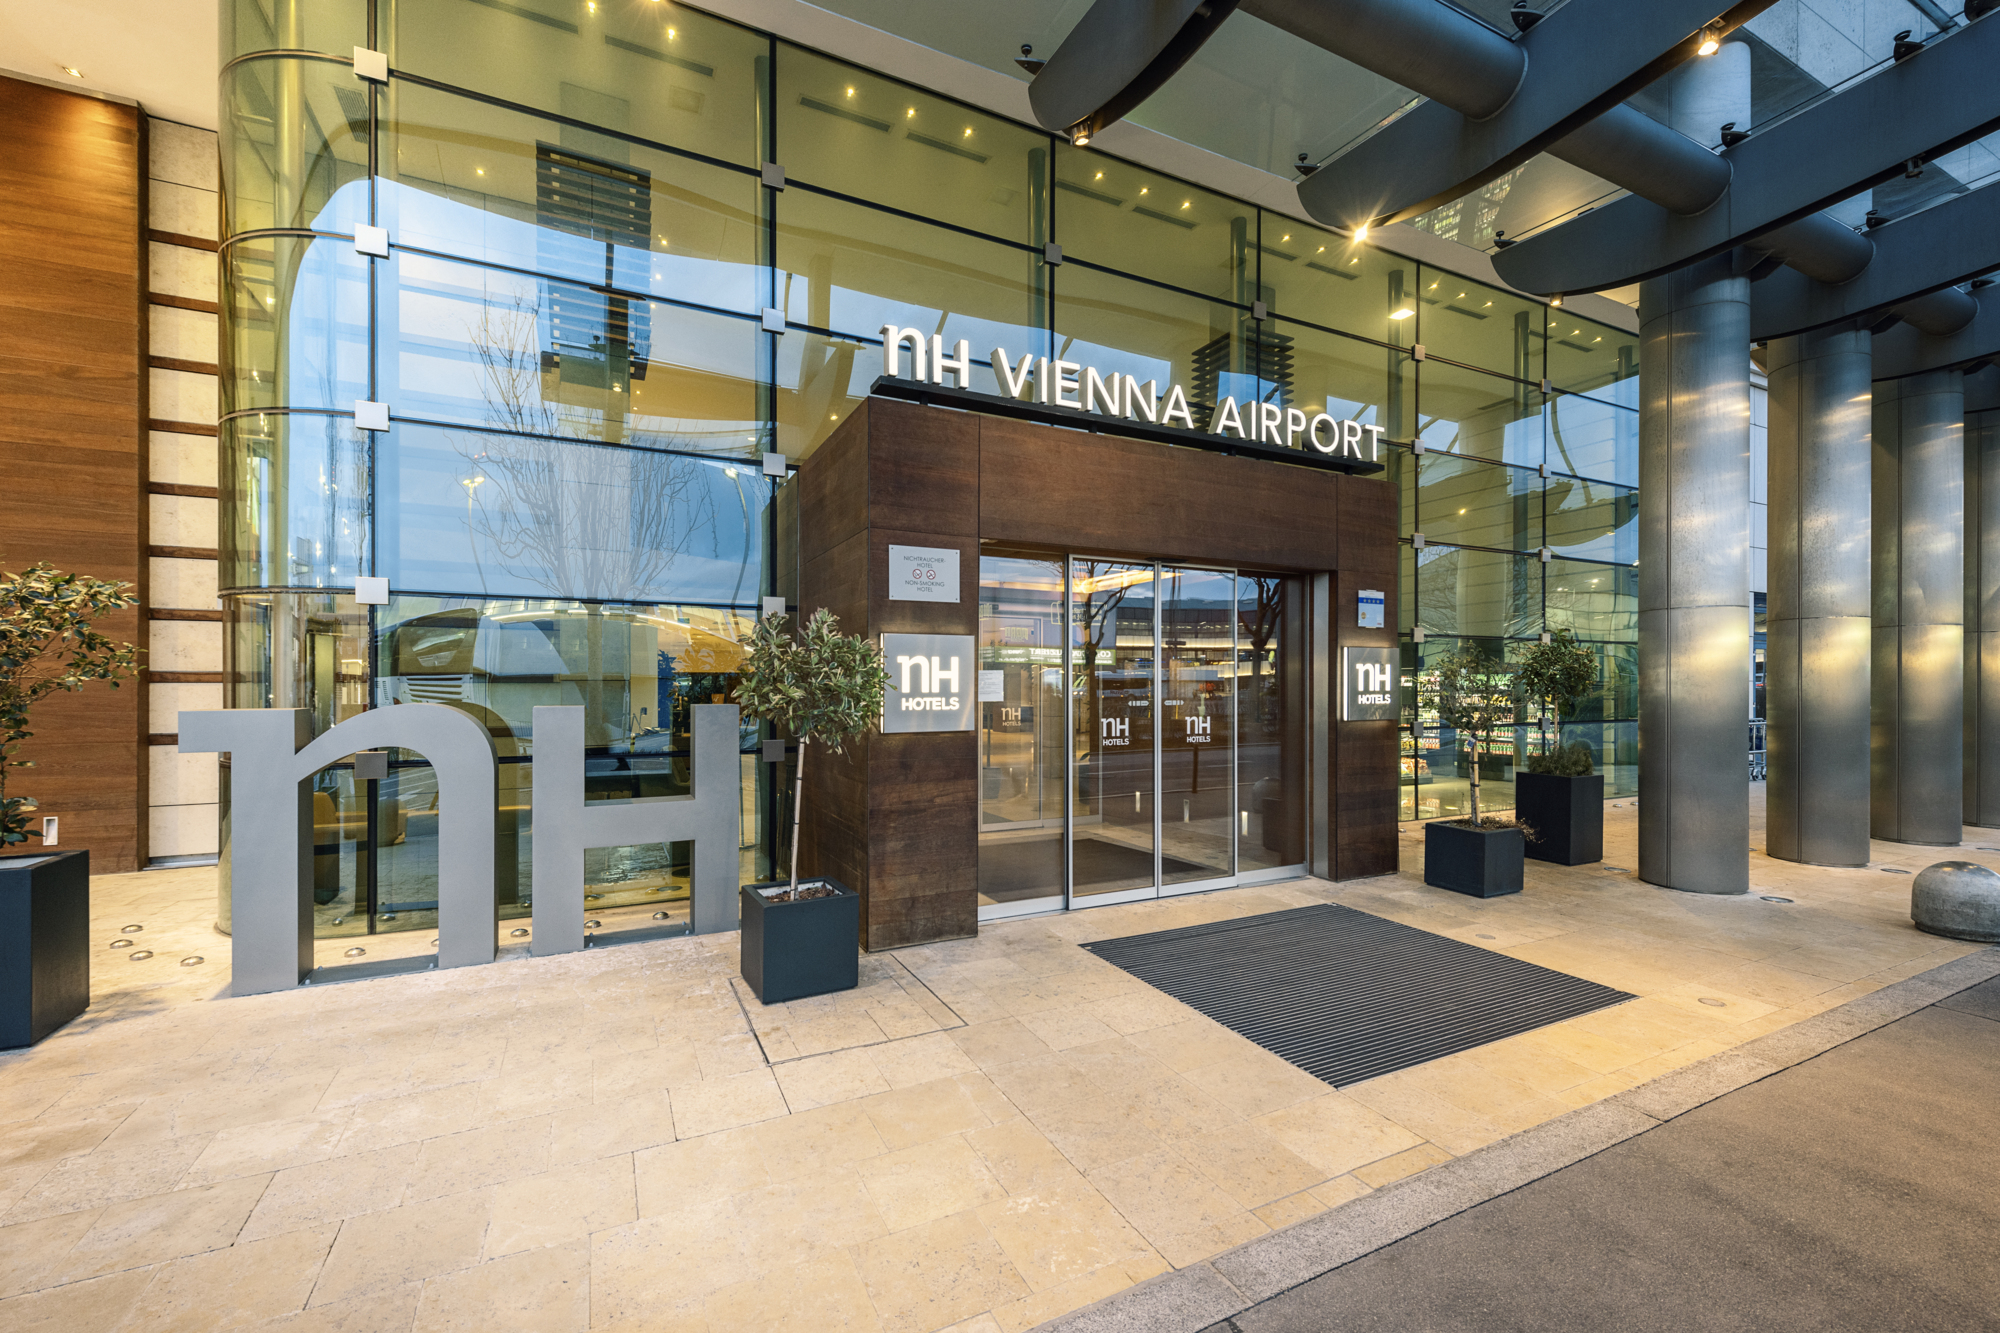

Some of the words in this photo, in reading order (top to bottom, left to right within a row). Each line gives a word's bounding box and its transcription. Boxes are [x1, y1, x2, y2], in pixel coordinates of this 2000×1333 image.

[991, 346, 1195, 429] VIENNA
[1208, 395, 1385, 462] AIRPORT
[903, 555, 946, 563] NICHTRAUCHER-
[1358, 694, 1391, 704] HOTELS
[901, 697, 960, 711] HOTELS
[1102, 738, 1130, 746] HOTELS
[1186, 735, 1211, 743] HOTELS
